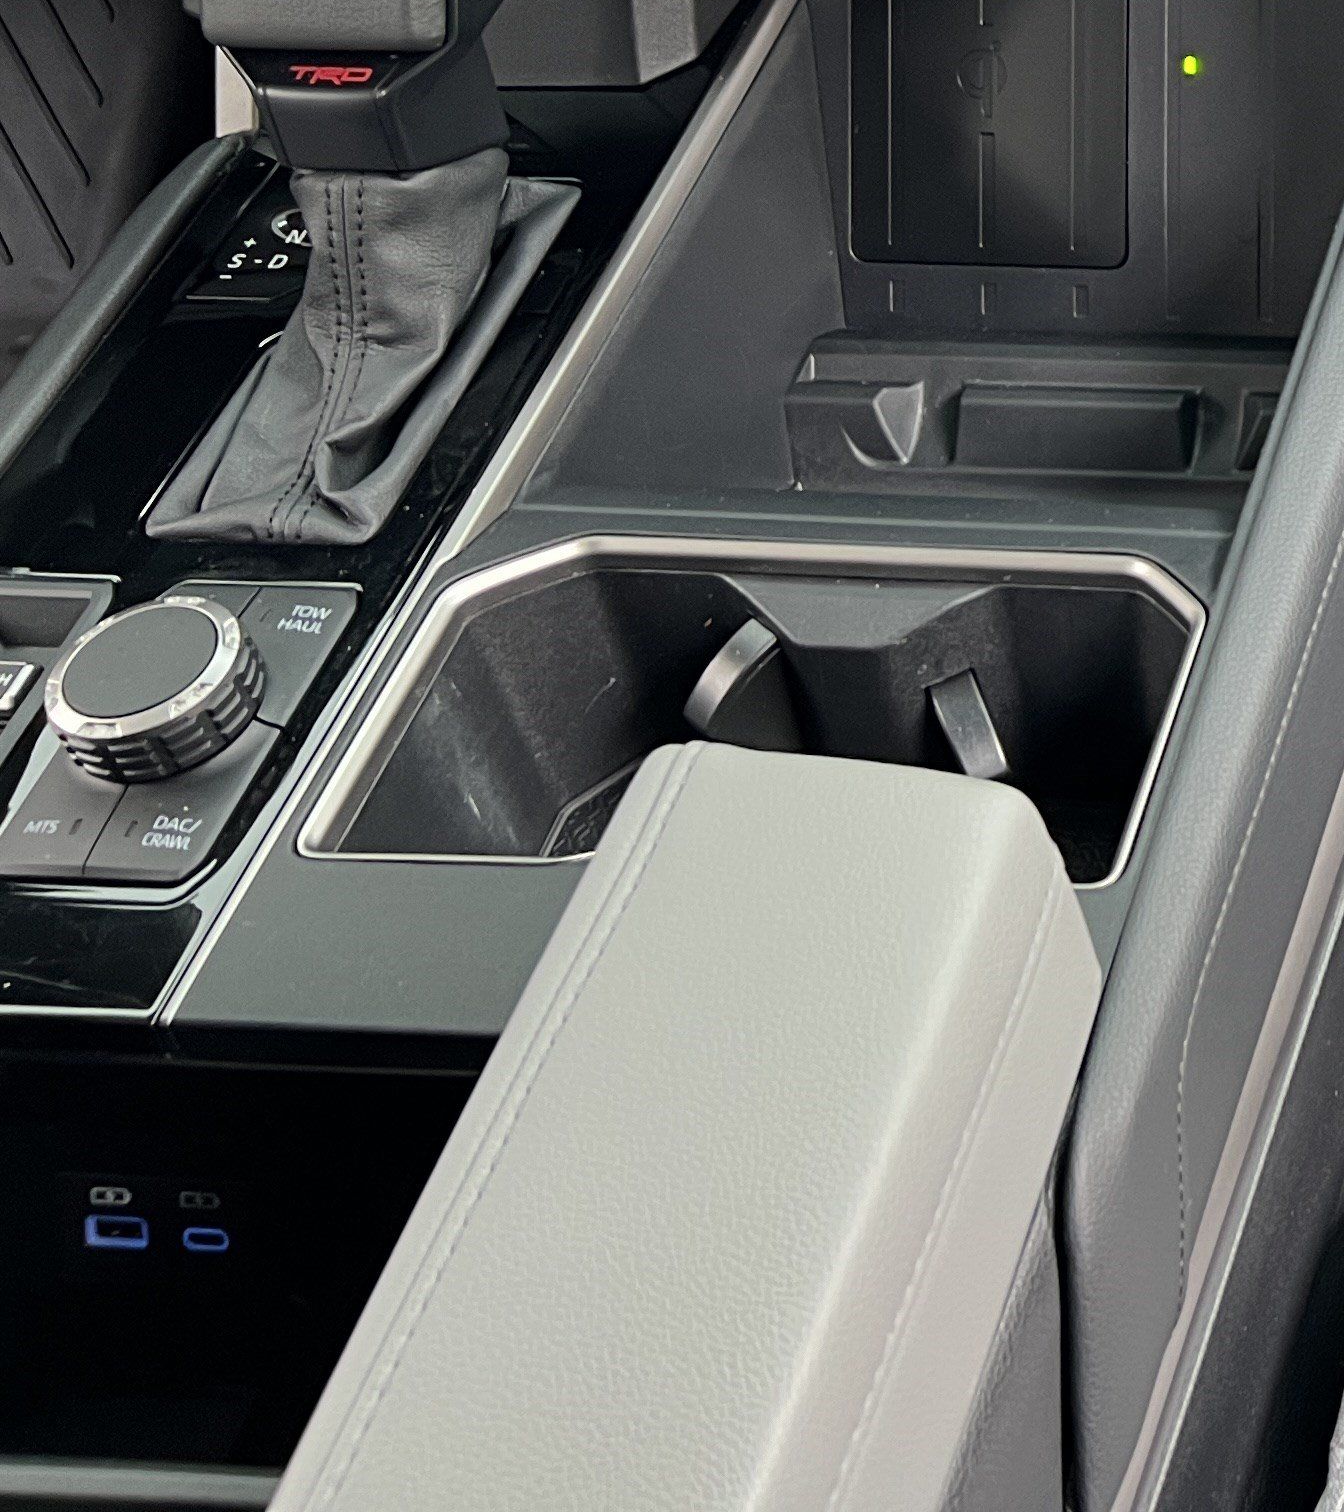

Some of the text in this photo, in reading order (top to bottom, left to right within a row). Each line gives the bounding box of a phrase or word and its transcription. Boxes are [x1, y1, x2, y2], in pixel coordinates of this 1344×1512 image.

[289, 65, 374, 85] TRD
[285, 229, 307, 244] N
[227, 253, 289, 269] S D
[291, 604, 332, 620] TOW
[277, 618, 322, 634] HAUL
[23, 819, 61, 834] MTS
[152, 815, 203, 833] DAC/
[141, 831, 191, 851] CRAWL
